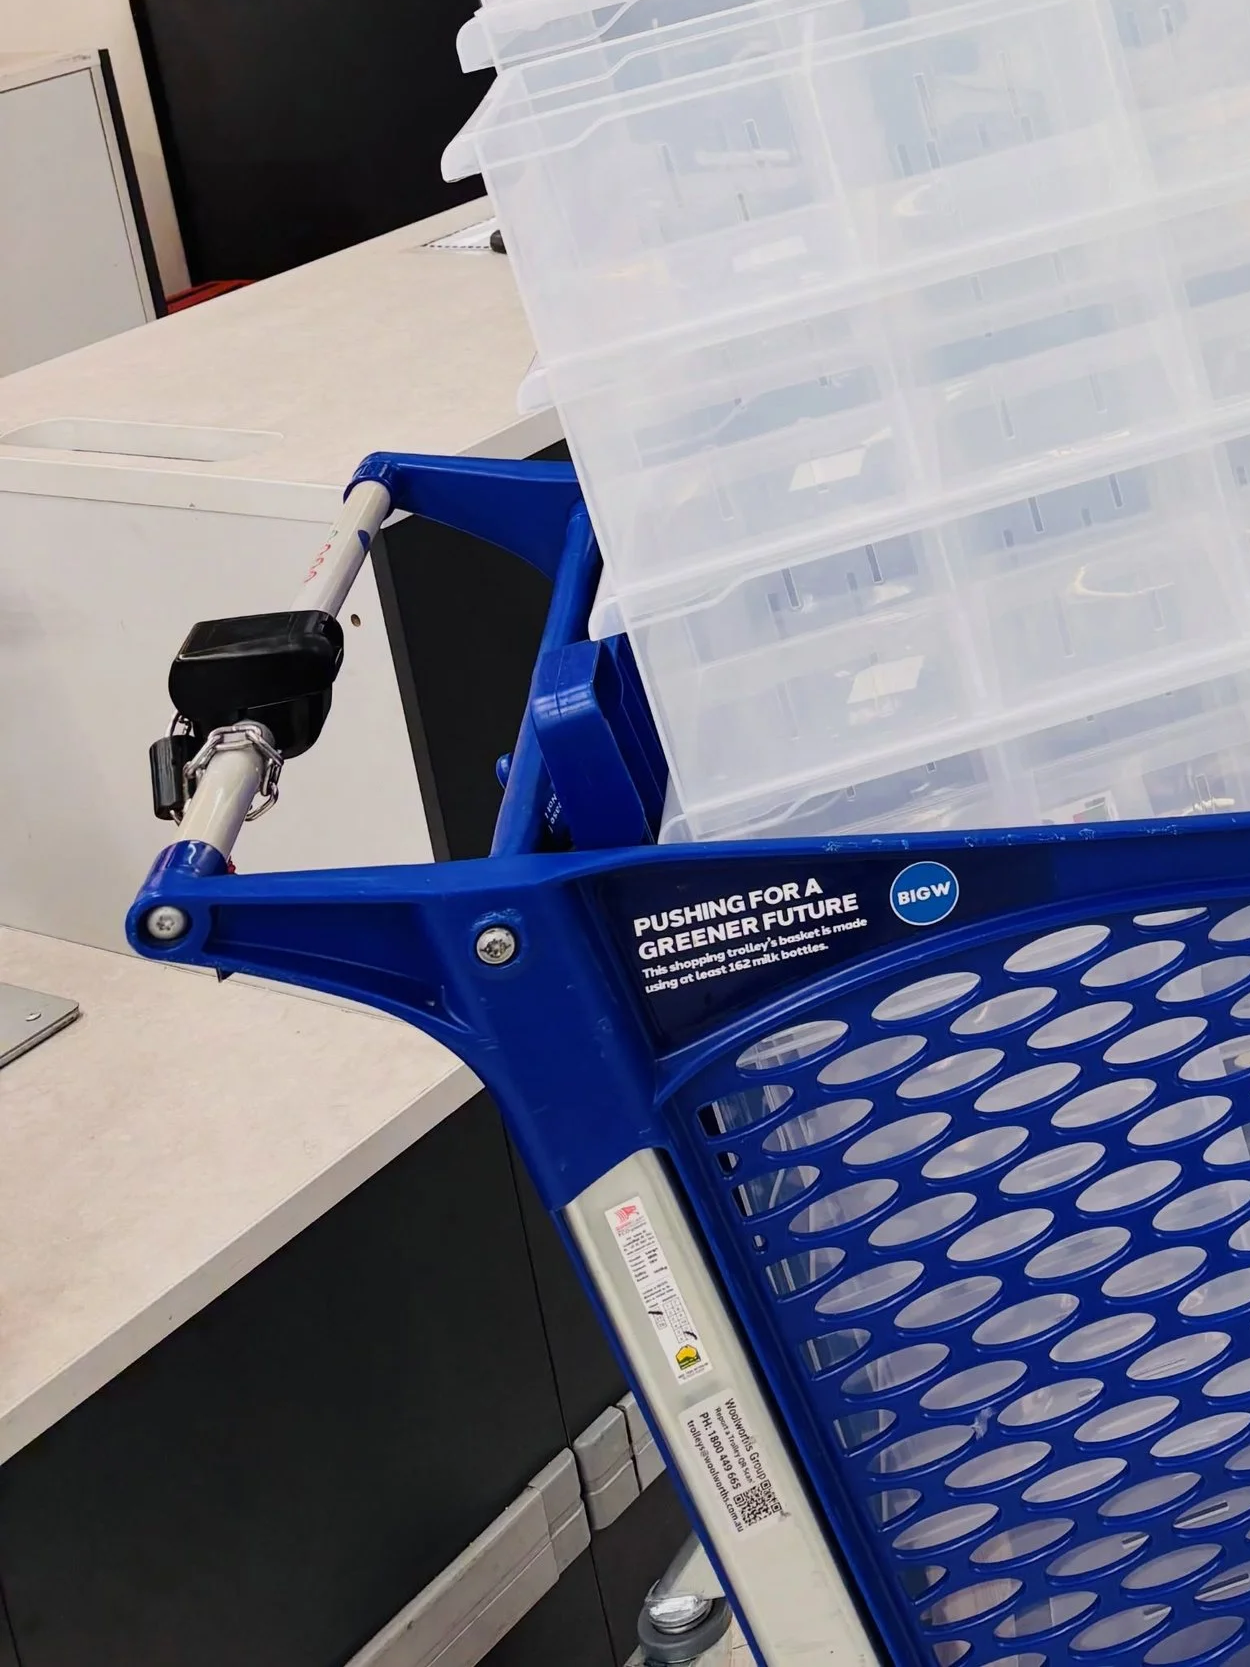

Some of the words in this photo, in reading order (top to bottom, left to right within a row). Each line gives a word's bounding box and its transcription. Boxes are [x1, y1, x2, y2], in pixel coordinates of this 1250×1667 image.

[633, 895, 746, 937] PUSHING
[748, 882, 801, 910] FOR
[804, 877, 824, 898] A
[638, 917, 760, 960] GREENER
[762, 893, 859, 931] FUTURE
[642, 966, 668, 979] This
[669, 952, 726, 973] shopping
[727, 937, 778, 956] trolley's
[779, 927, 821, 945] basket
[821, 925, 832, 936] is
[832, 918, 868, 934] made
[645, 977, 679, 994] using
[679, 974, 694, 985] at
[695, 965, 728, 981] least
[728, 959, 752, 973] 162
[752, 952, 780, 967] milk
[781, 942, 829, 960] bottles.
[699, 1411, 712, 1431] PH:
[707, 1430, 725, 1454] 1800
[719, 1453, 733, 1472] 449
[727, 1471, 742, 1490] 665
[725, 1397, 754, 1453] Woolworths
[749, 1451, 767, 1481] Group
[727, 1434, 740, 1459] Trolley
[737, 1456, 747, 1469] QR
[686, 1419, 744, 1533] trolleys@woolworths.com.au
